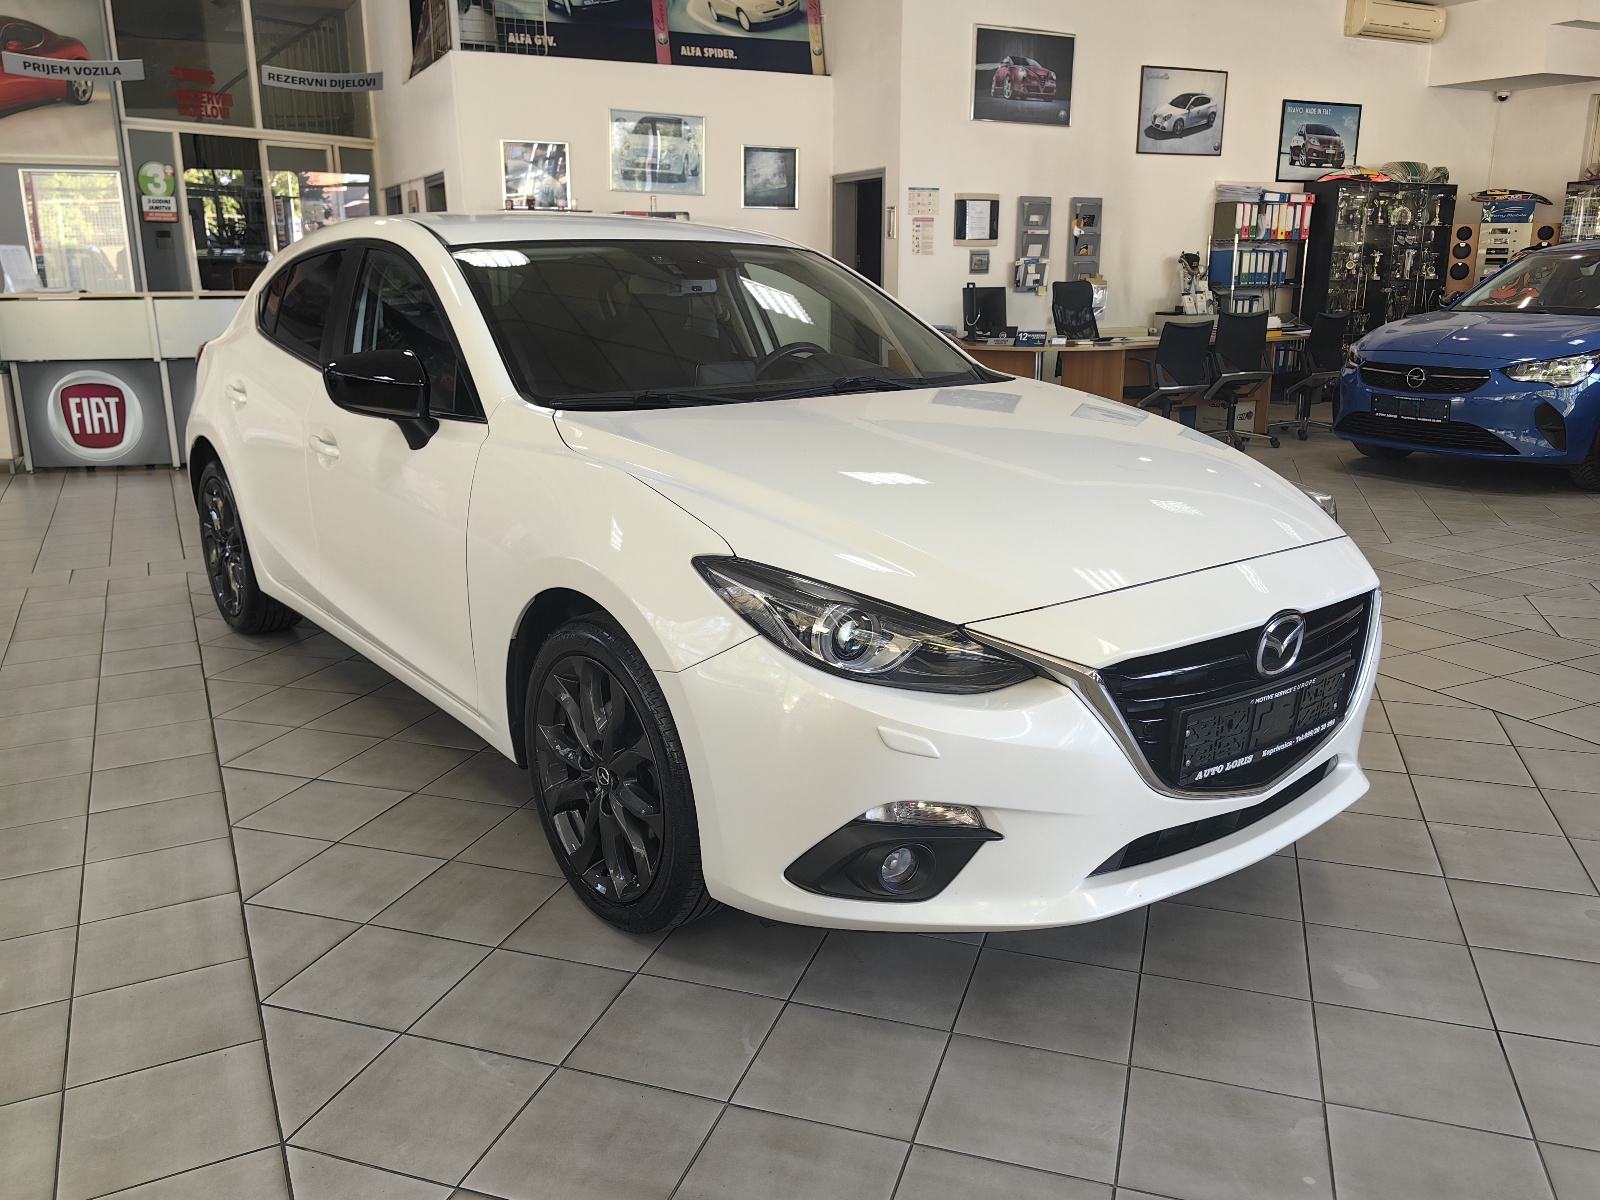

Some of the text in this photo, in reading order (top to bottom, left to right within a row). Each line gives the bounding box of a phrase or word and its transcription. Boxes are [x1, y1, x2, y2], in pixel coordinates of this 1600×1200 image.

[508, 33, 532, 44] ALFA
[681, 46, 738, 60] ALFA SPIDER.
[23, 61, 121, 76] PRIJEM VOZILA
[268, 72, 376, 89] REZERVNI DIJELOVI
[1018, 332, 1028, 341] 12
[68, 397, 119, 434] FIAT
[1195, 764, 1223, 780] AUTO
[1225, 755, 1254, 771] LORIS
